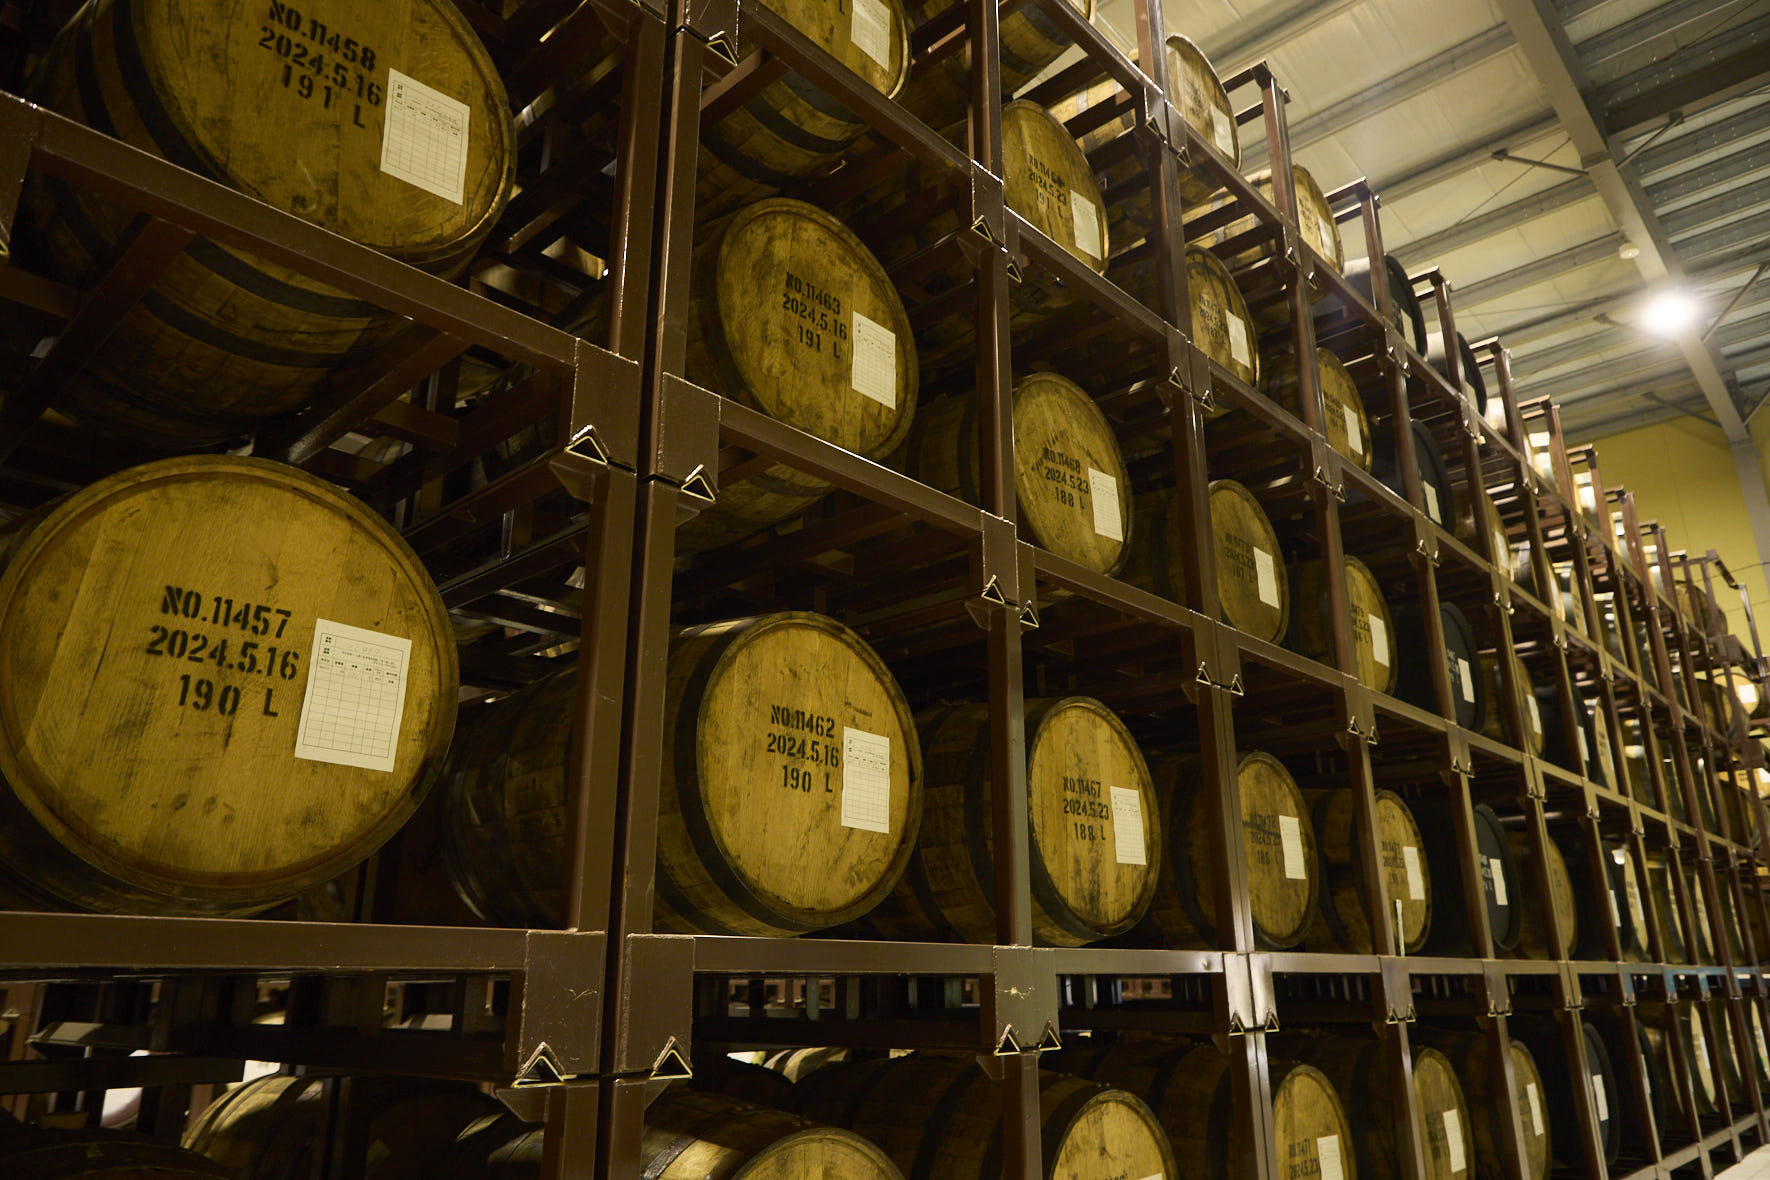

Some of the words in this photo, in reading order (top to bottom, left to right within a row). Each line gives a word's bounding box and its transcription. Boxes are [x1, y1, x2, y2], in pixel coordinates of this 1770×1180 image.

[270, 0, 376, 72] NO.11458
[259, 26, 382, 106] 2024.5.16
[281, 64, 332, 109] 191
[353, 104, 365, 129] L
[785, 271, 841, 316] NO.11463
[782, 293, 848, 340] 2024.5.16
[798, 325, 821, 352] 191
[833, 342, 841, 359] L
[1044, 466, 1089, 494] 2024.5.23
[160, 584, 292, 639] NO.11457
[146, 624, 300, 681] 2024.5.16
[178, 674, 241, 716] 190
[263, 688, 279, 718] L
[770, 704, 835, 739] NO.11462
[766, 732, 840, 768] 2024.5.16
[782, 765, 812, 793] 190
[825, 772, 833, 793] L
[1062, 775, 1101, 799] NO.11467
[1062, 798, 1109, 821] 2024.5.23
[1100, 824, 1106, 841] L
